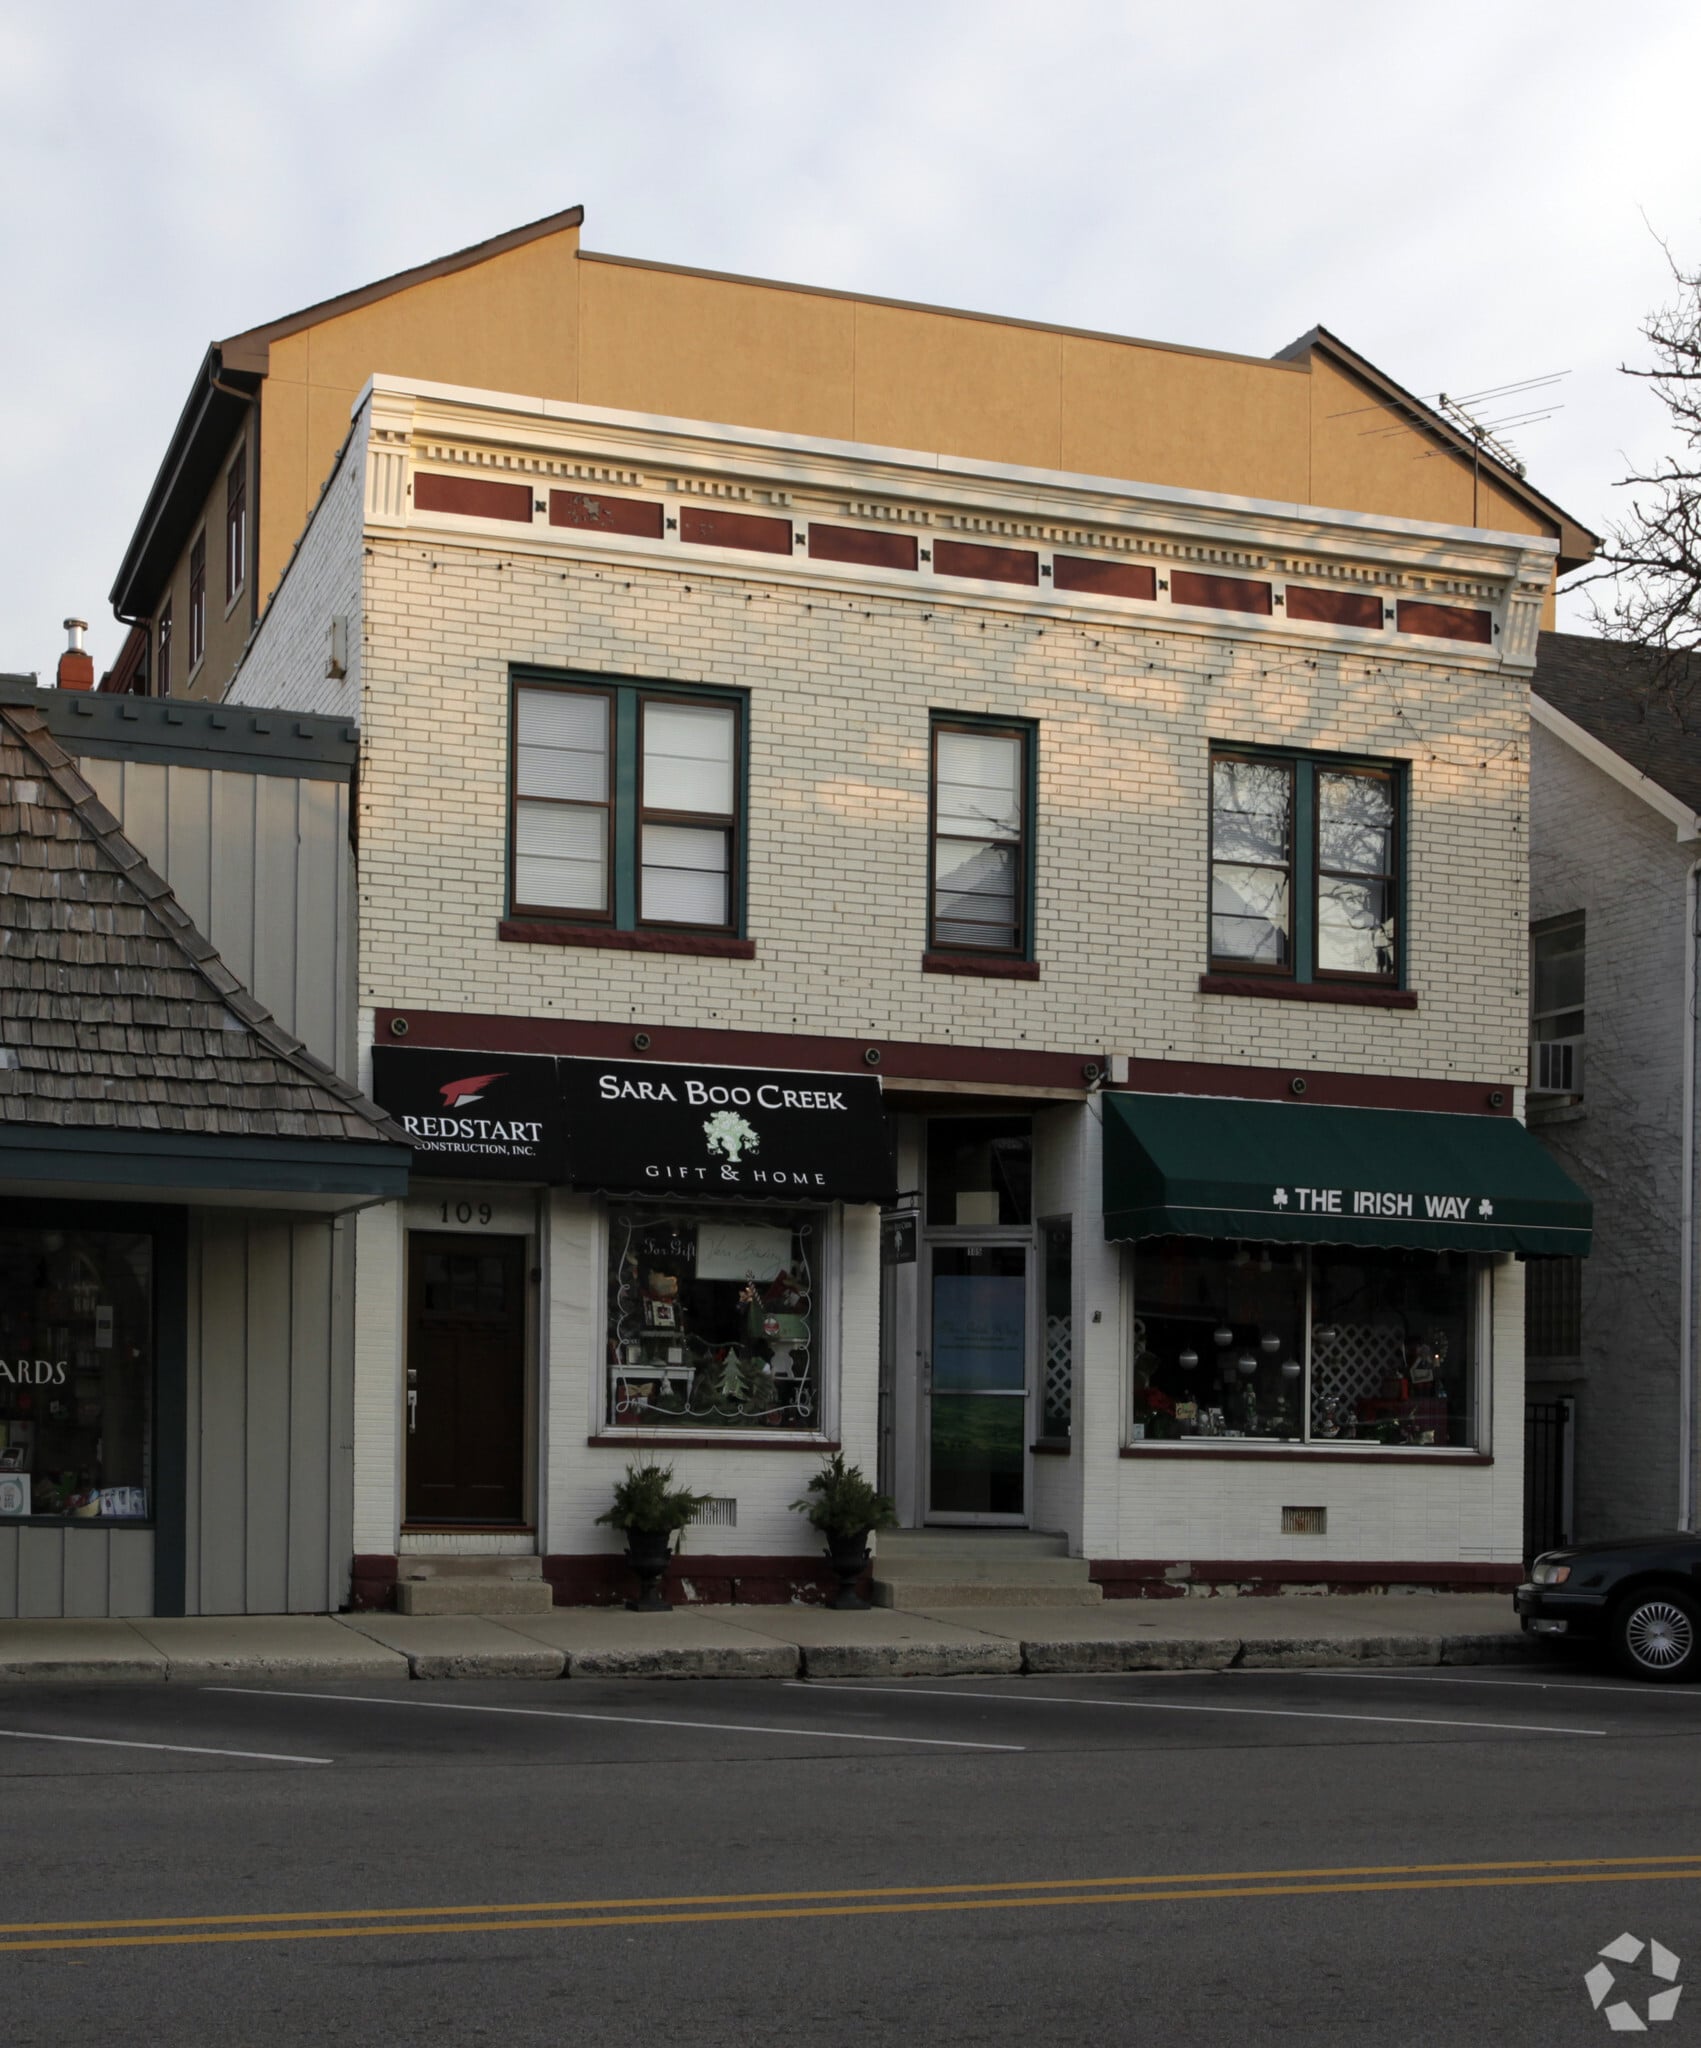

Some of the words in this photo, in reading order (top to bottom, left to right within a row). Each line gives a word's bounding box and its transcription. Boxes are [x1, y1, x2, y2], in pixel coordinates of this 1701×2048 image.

[757, 1083, 849, 1111] CREEK
[402, 1115, 543, 1143] REDSTART
[511, 1145, 537, 1156] INC.
[645, 1165, 707, 1180] GIFT
[720, 1163, 741, 1182] &
[753, 1170, 827, 1186] HOME
[440, 1201, 493, 1226] 109
[1294, 1187, 1342, 1213] THE
[1353, 1191, 1413, 1217] IRISH
[1425, 1196, 1471, 1220] WAY
